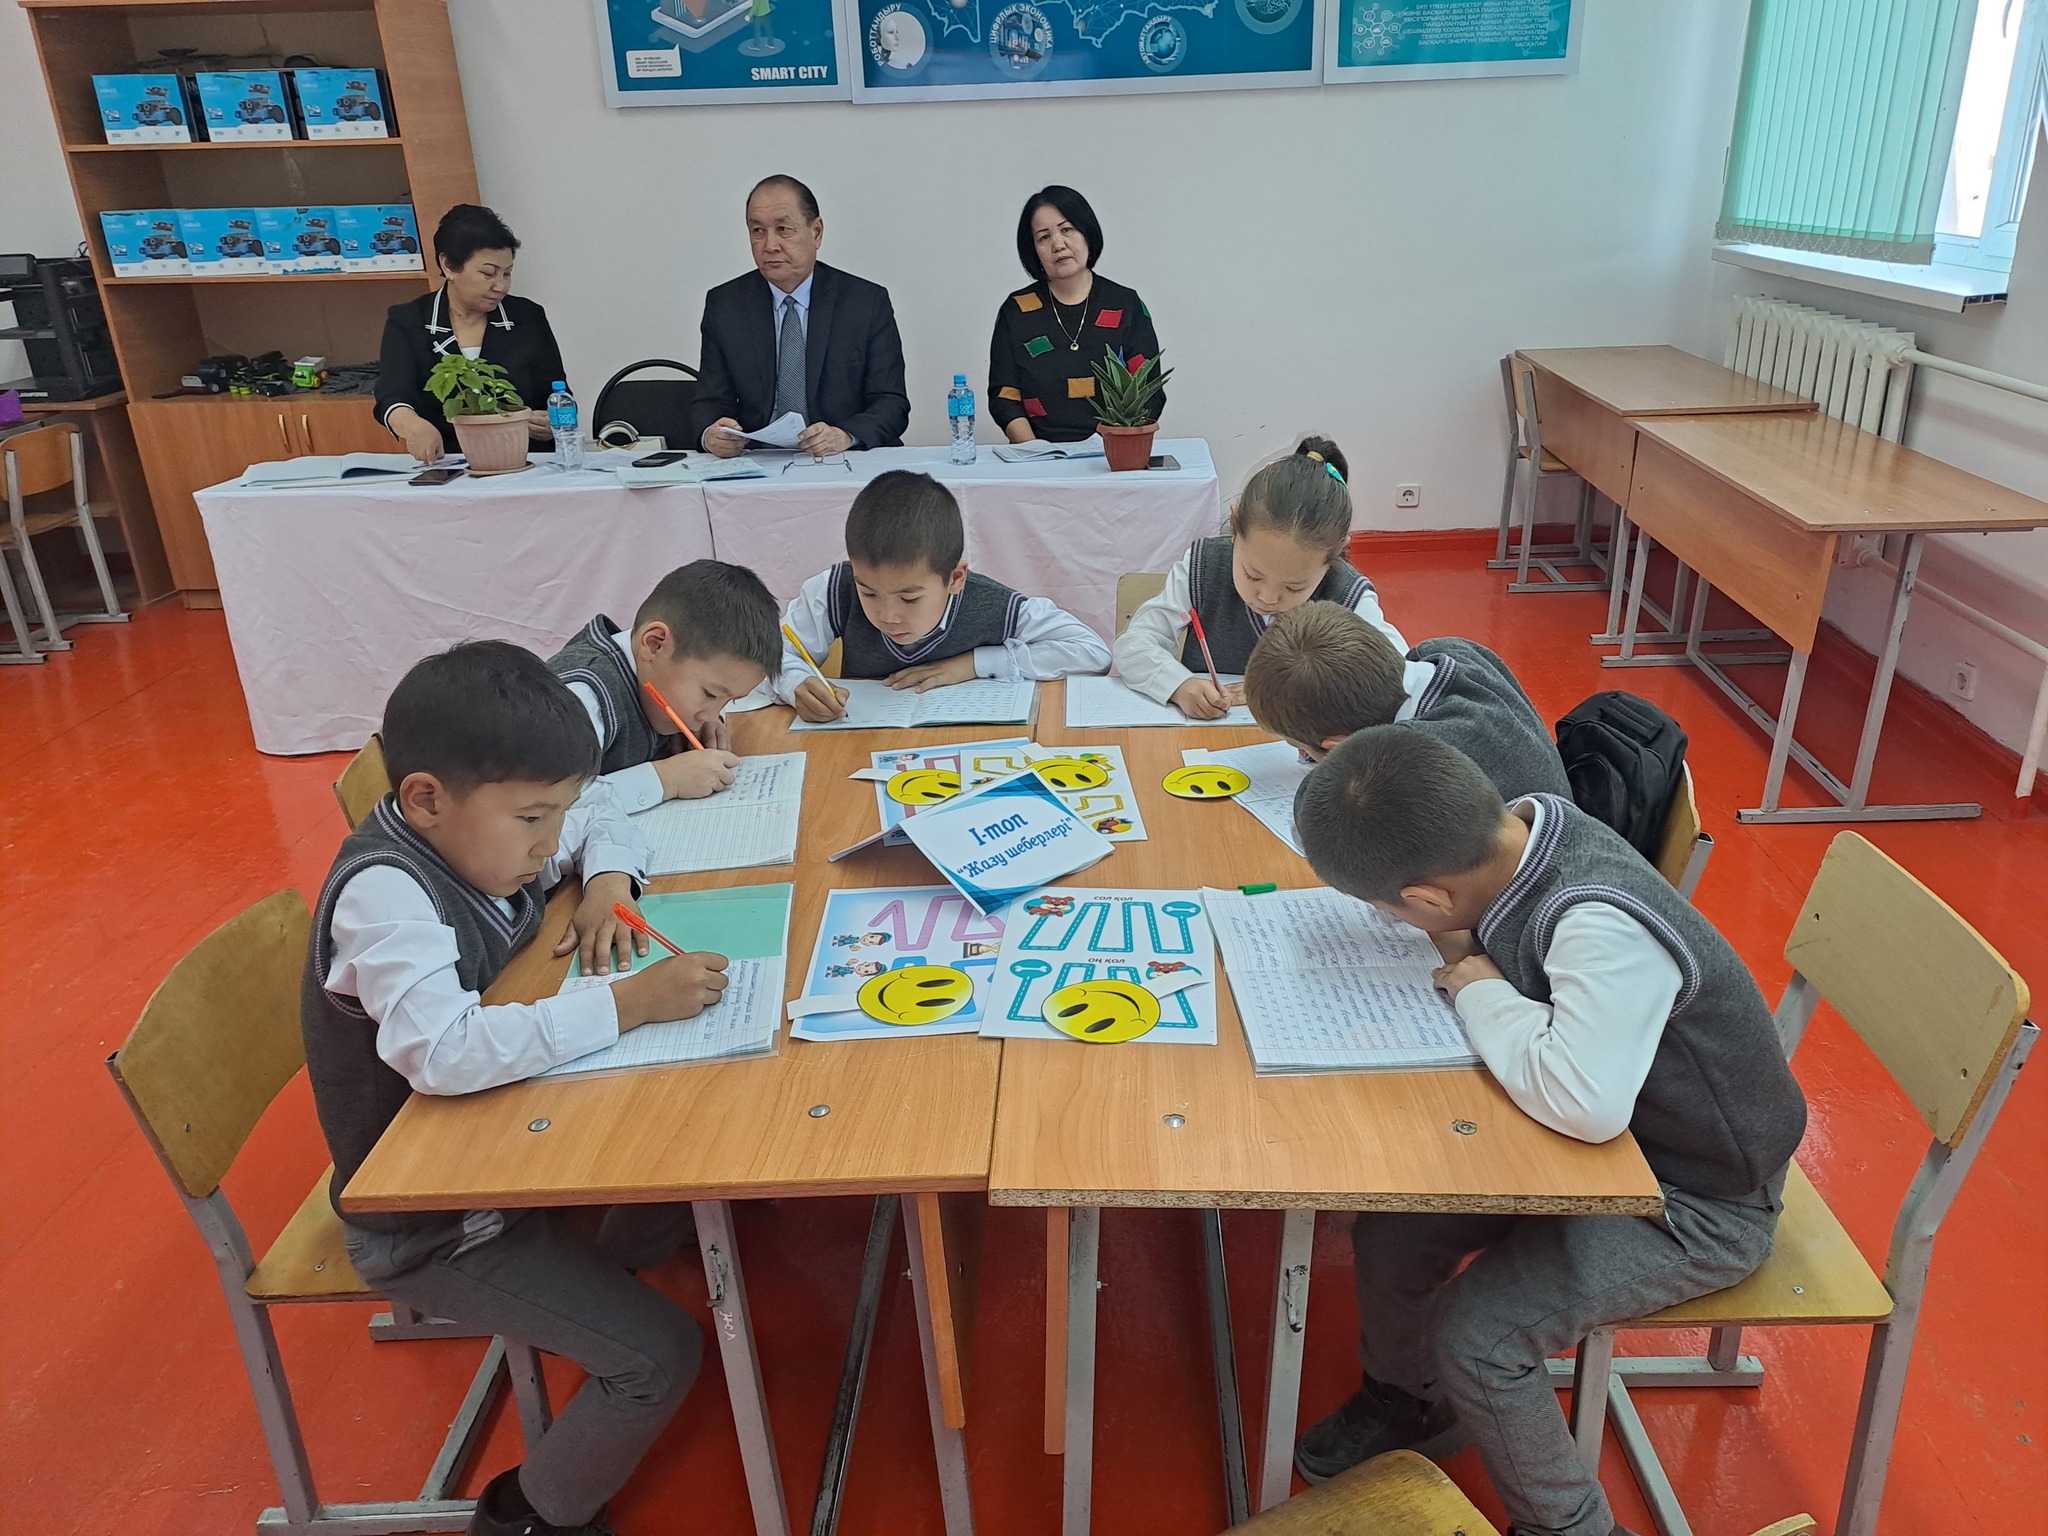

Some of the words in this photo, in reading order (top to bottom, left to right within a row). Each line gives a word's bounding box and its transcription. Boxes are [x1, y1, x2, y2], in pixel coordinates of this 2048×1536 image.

[869, 3, 902, 67] РОБОТТАНДЫРУ
[1019, 3, 1053, 49] ЭКОНОМИКА
[1139, 15, 1172, 64] АВТОМАТТАНДЫРУ
[751, 66, 797, 81] SMART
[798, 65, 828, 80] CITY
